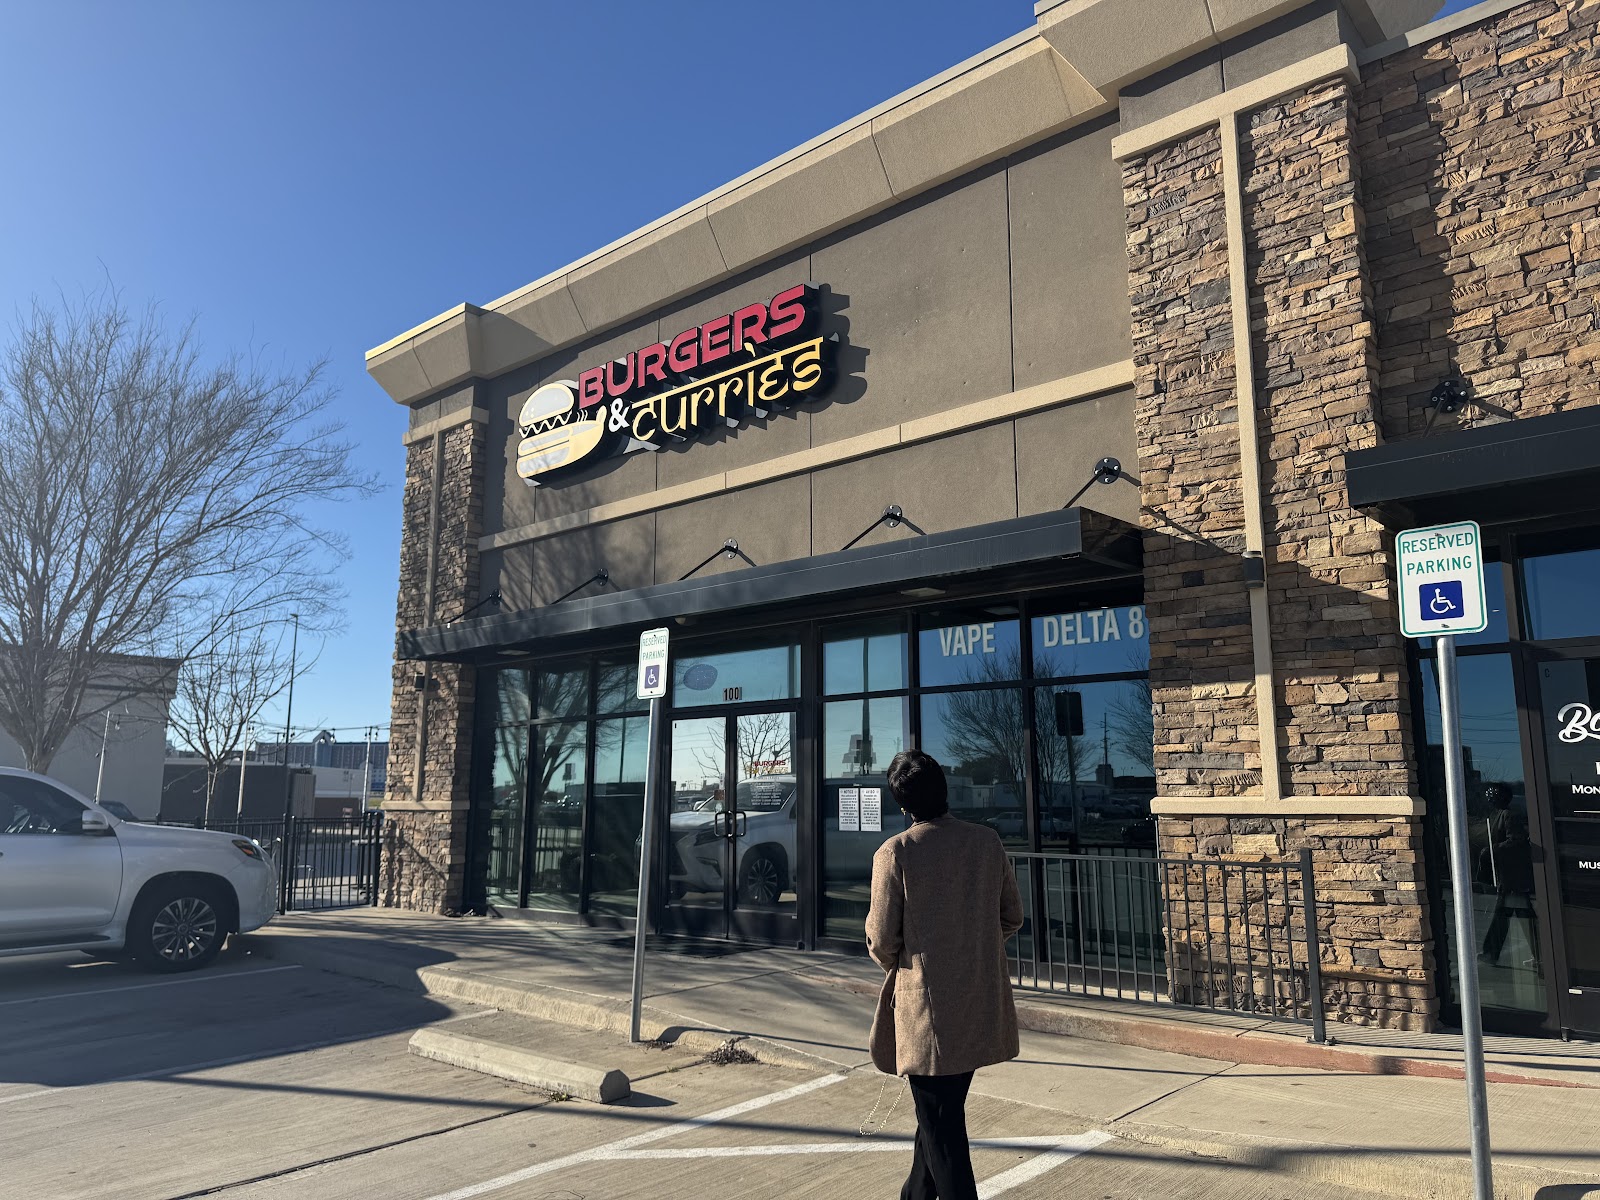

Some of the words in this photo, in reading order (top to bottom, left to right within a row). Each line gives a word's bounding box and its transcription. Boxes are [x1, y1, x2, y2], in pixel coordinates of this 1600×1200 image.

[579, 284, 805, 410] BURGERS
[608, 398, 630, 433] &
[1402, 532, 1474, 554] RESERVED
[1407, 555, 1472, 576] PARKING
[1043, 609, 1121, 648] DELTA
[1128, 606, 1144, 639] 8
[642, 635, 666, 647] RESERVED
[939, 622, 995, 657] VAPE
[642, 649, 664, 661] PARKING
[723, 687, 739, 701] 100
